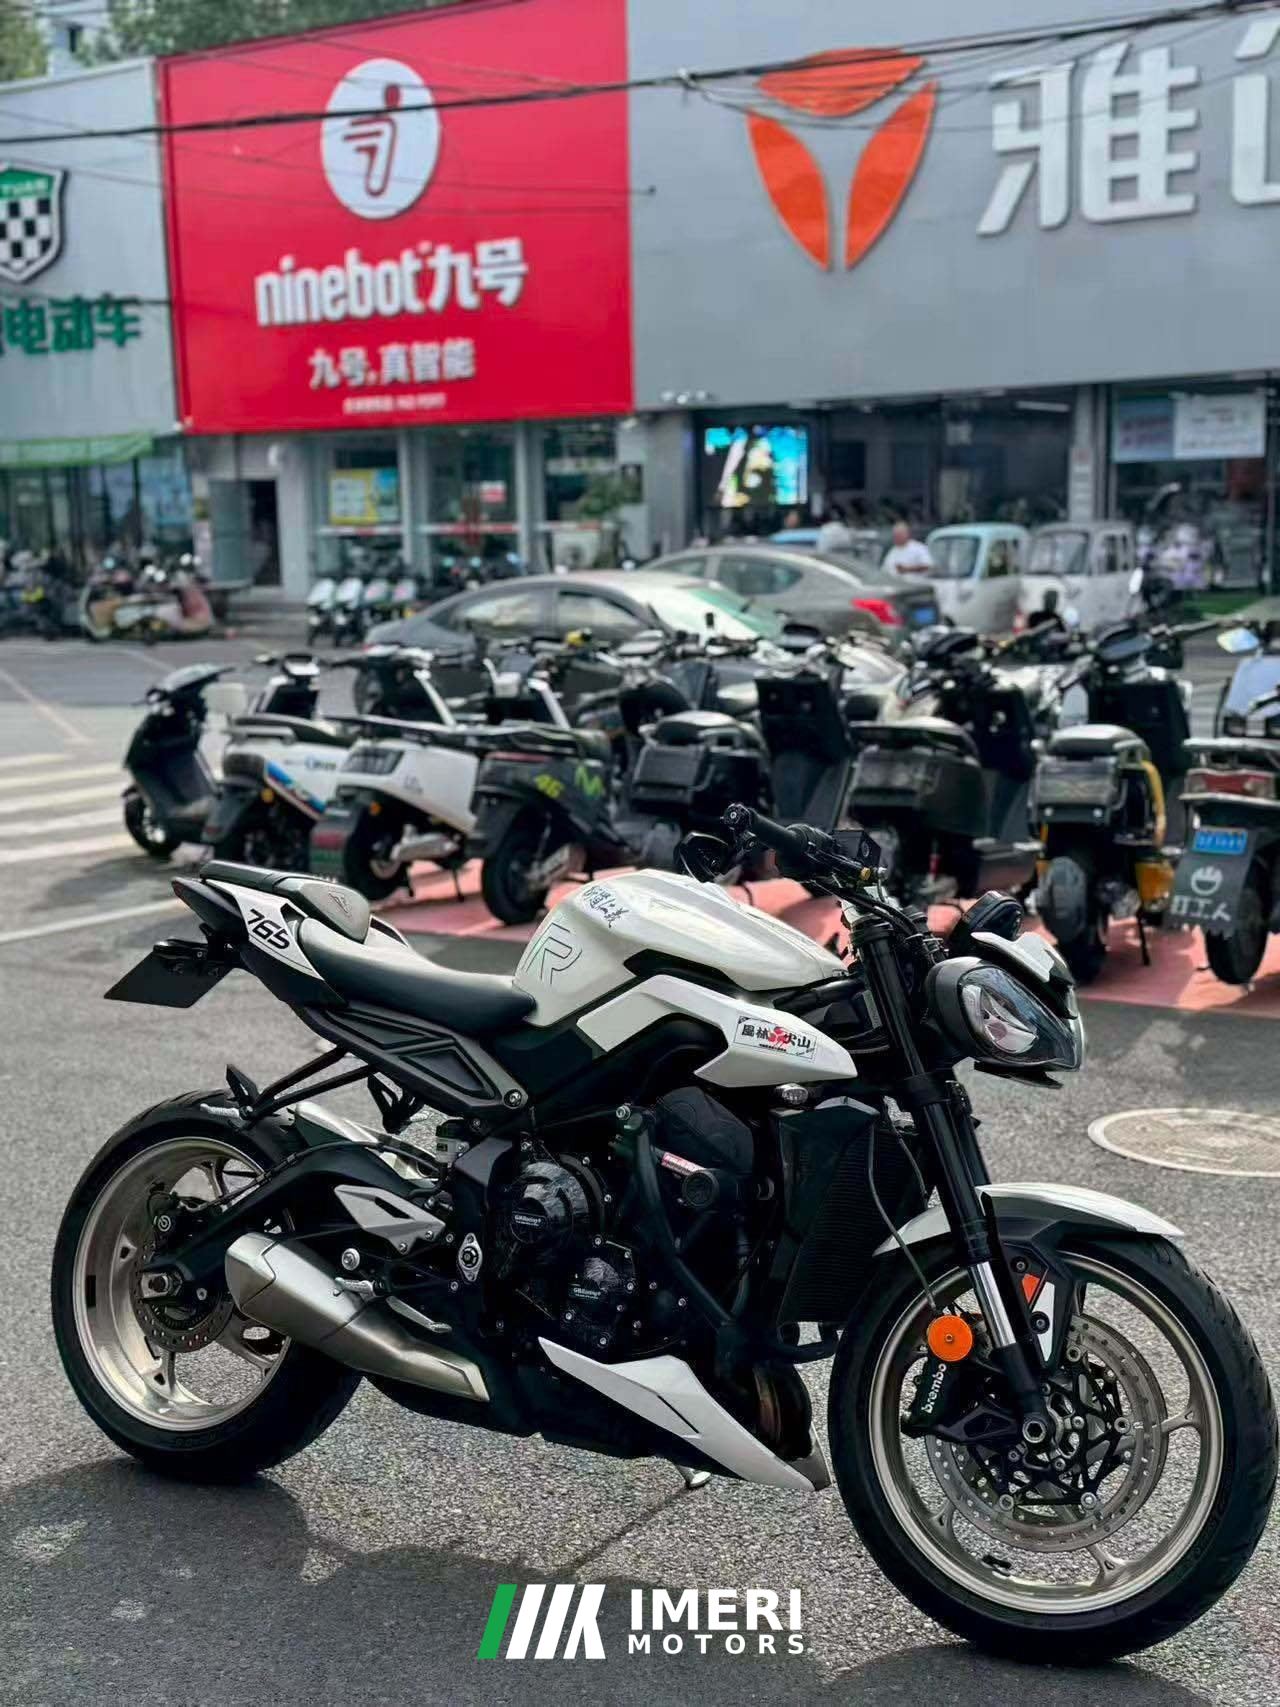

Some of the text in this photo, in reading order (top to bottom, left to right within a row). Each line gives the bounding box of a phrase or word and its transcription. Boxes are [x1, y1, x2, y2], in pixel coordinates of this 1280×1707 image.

[255, 236, 528, 327] ninebot 九号
[0, 293, 142, 358] 电动车
[247, 909, 290, 949] 765
[921, 1363, 947, 1414] brembo
